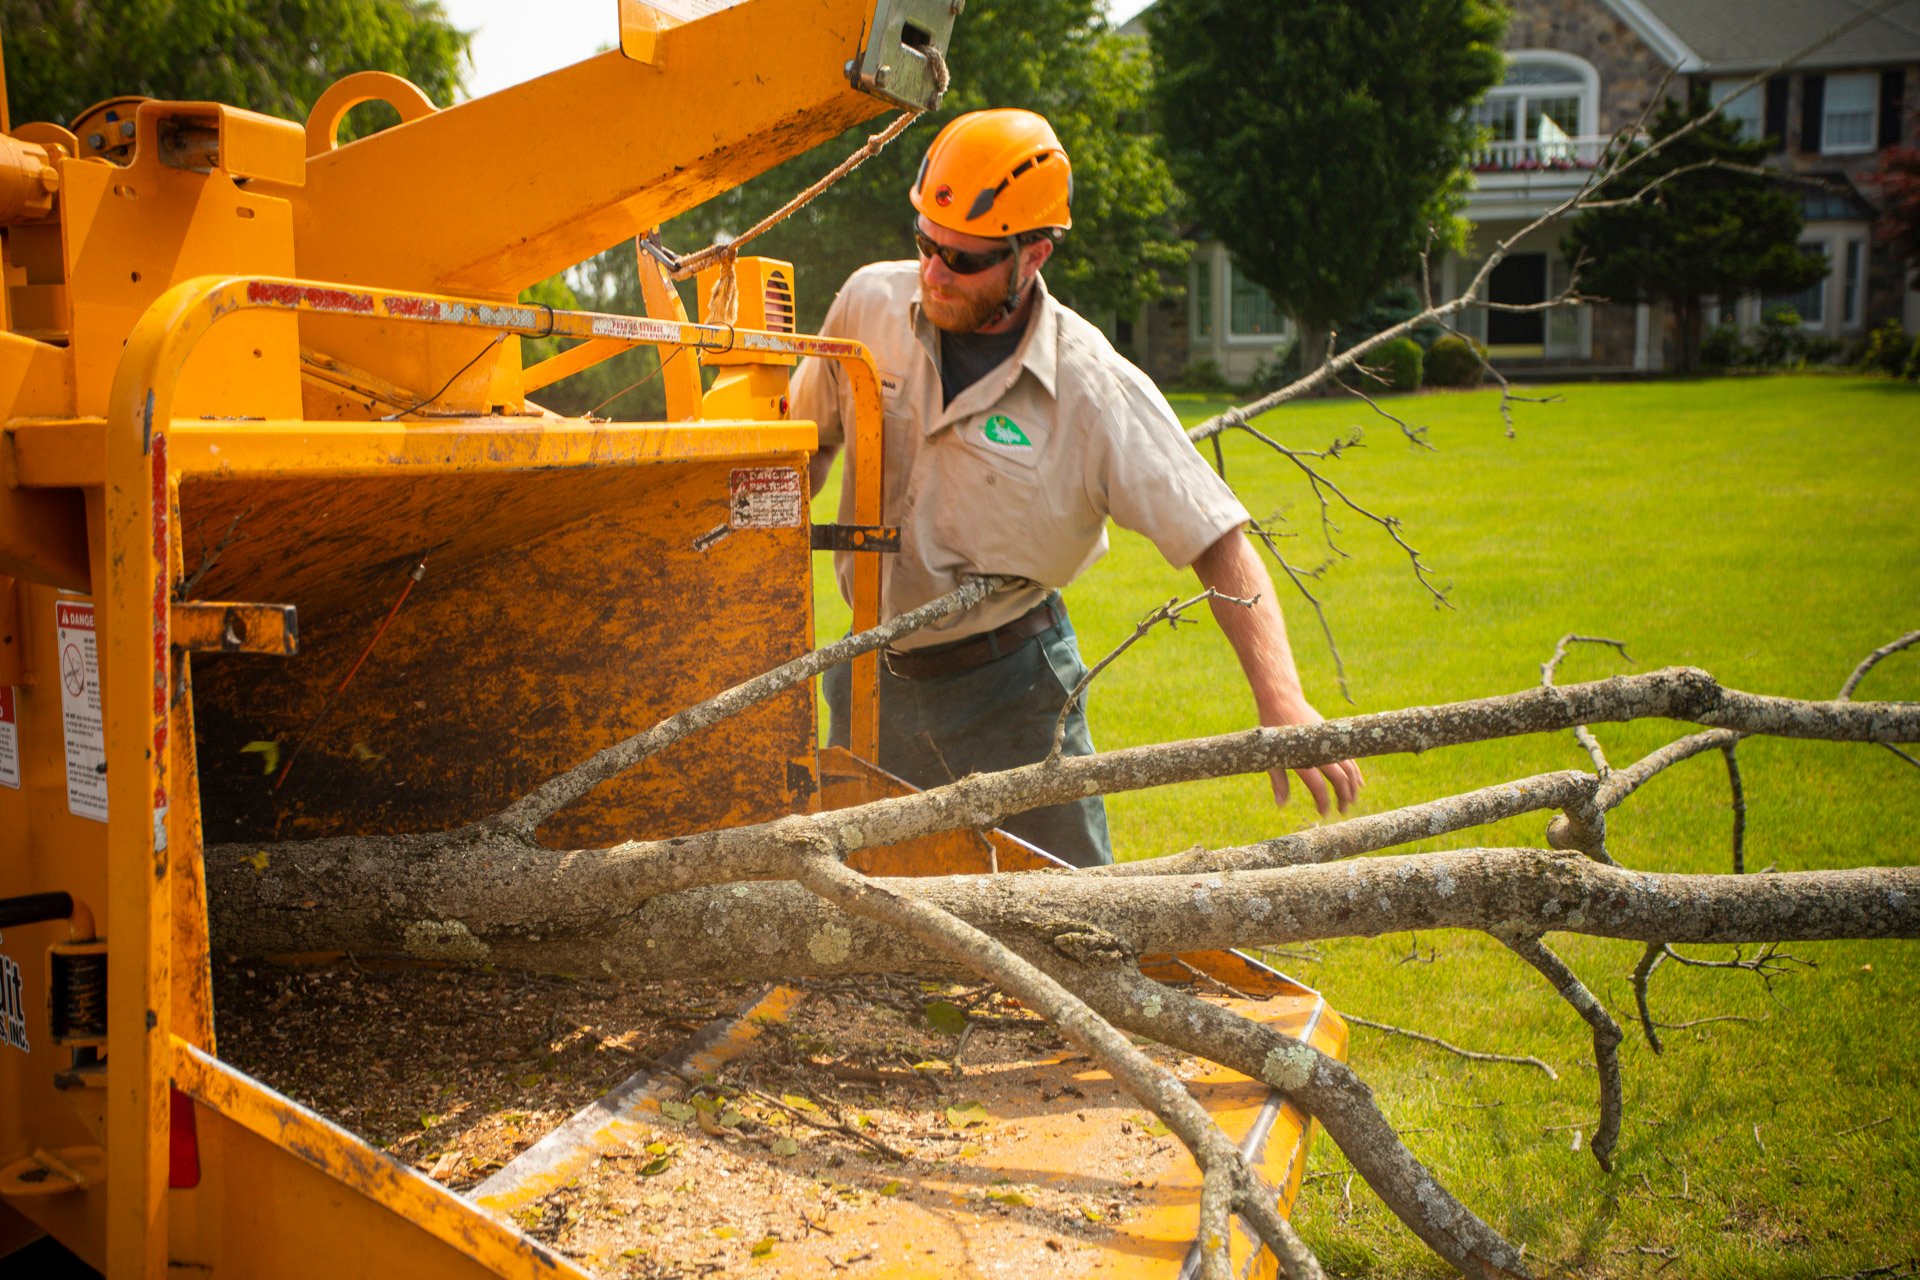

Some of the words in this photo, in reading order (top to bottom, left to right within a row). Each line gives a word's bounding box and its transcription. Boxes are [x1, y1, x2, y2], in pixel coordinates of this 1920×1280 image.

[612, 321, 628, 330] PUSH
[639, 321, 663, 334] REVERSE
[69, 612, 95, 627] DANGE
[9, 1020, 29, 1051] INC.
